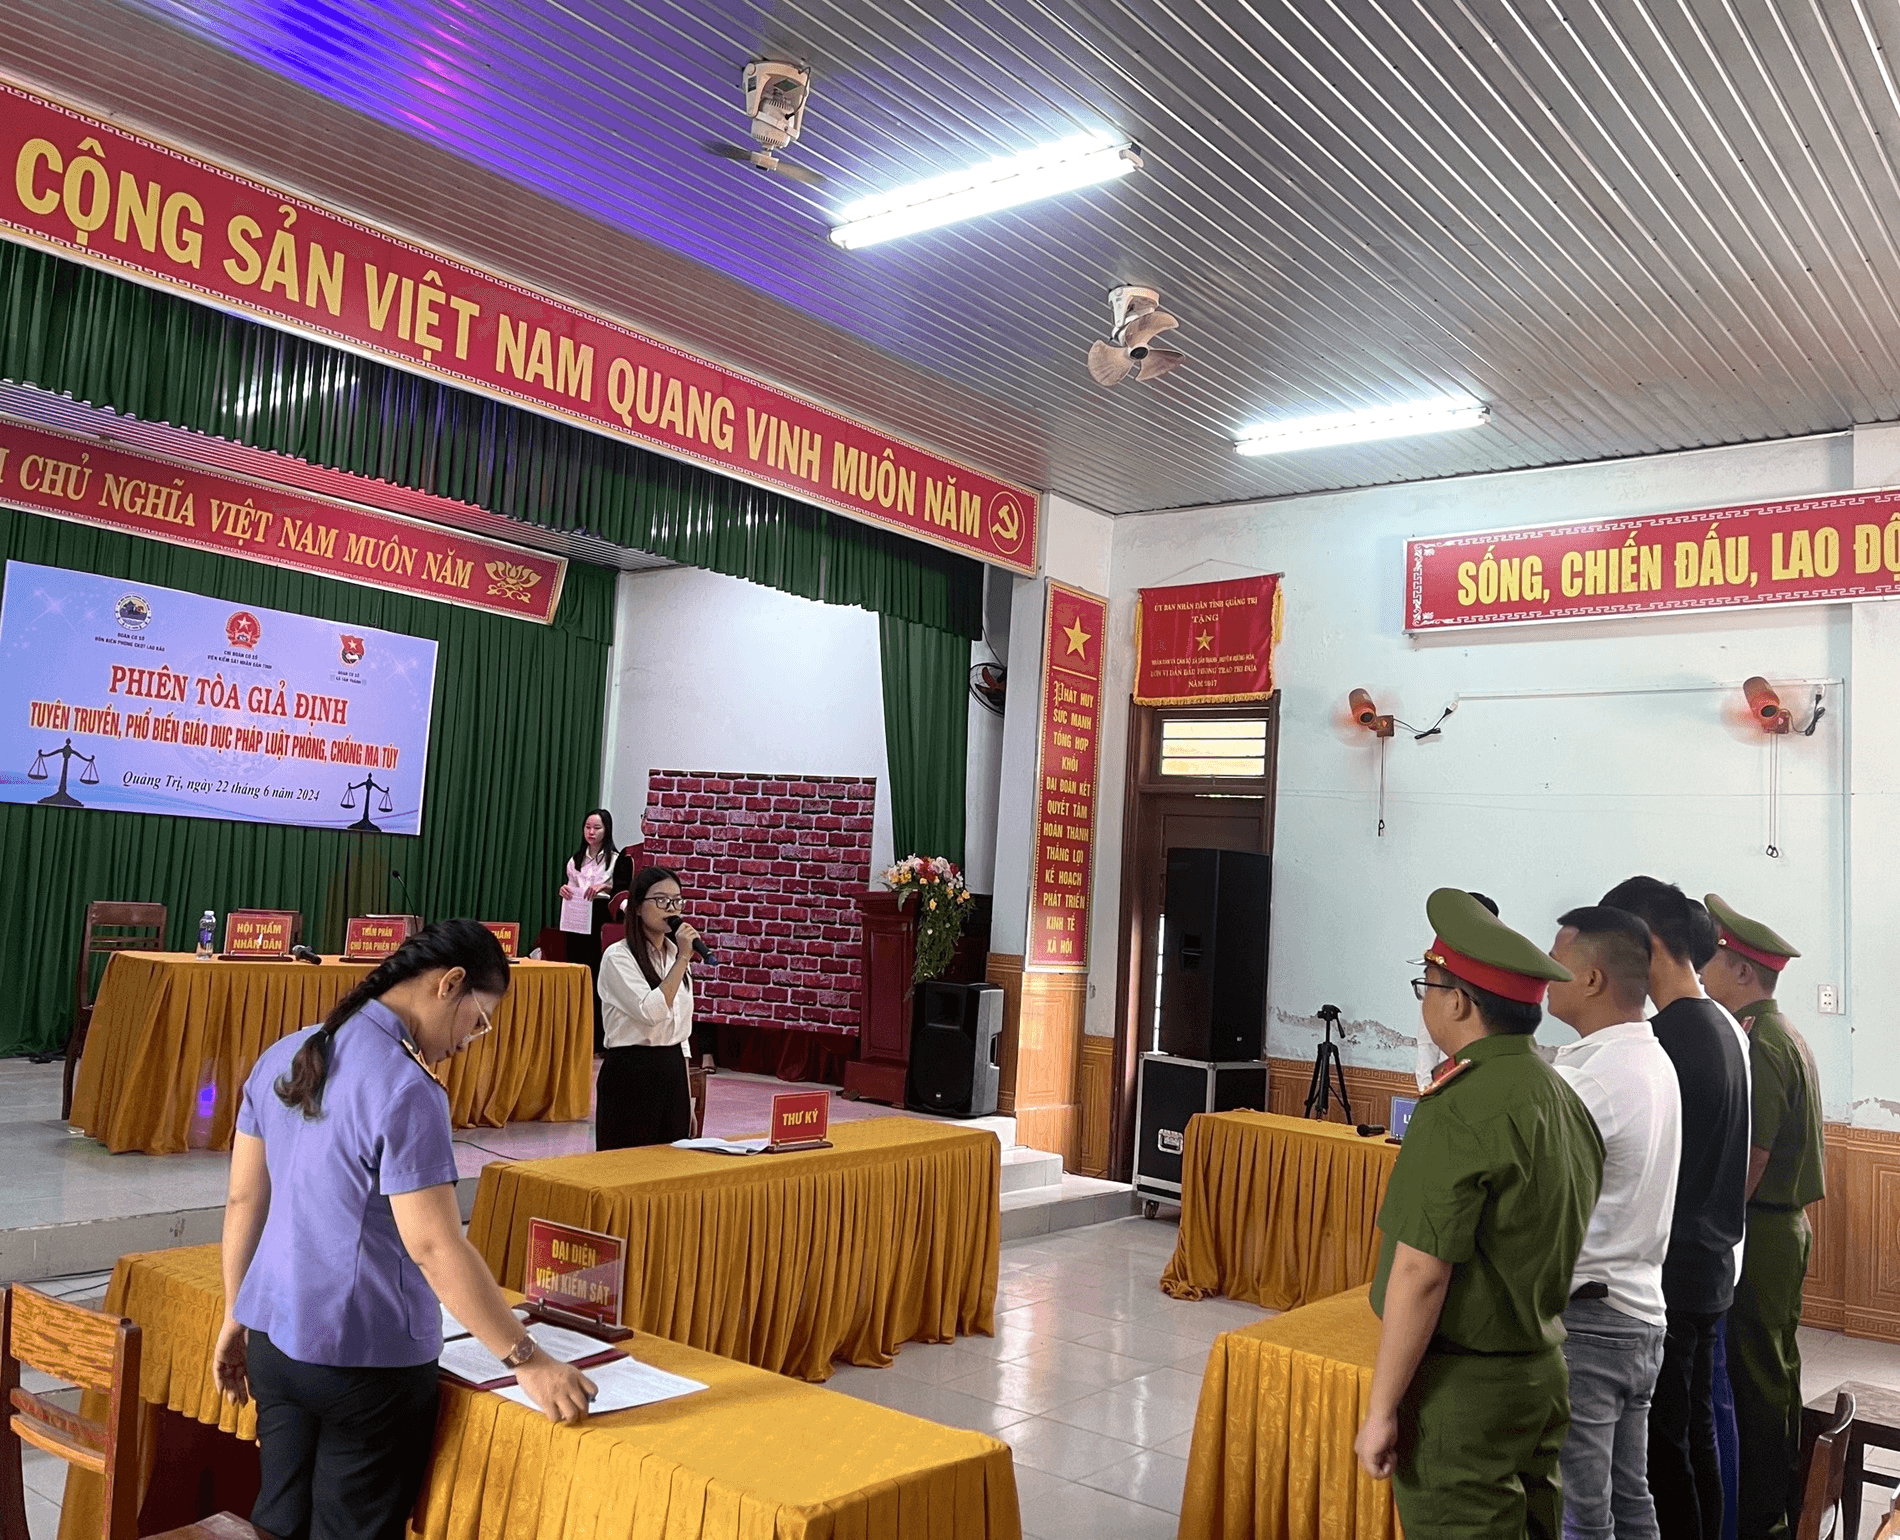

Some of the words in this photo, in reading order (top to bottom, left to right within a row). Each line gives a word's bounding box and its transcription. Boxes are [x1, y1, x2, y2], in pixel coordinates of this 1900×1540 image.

[15, 137, 205, 270] CỘNG
[223, 205, 345, 317] SẢN
[365, 270, 480, 362] VIỆT
[498, 315, 594, 402] NAM
[607, 357, 735, 453] QUANG
[747, 406, 823, 483] VINH
[832, 447, 917, 513] MUÔN
[924, 476, 981, 539] NĂM
[20, 453, 93, 500] CHỦ
[100, 478, 196, 527] NGHĨA
[210, 498, 272, 546] VIỆT
[280, 517, 339, 559] NAM
[348, 534, 417, 578] MUÔN
[420, 546, 474, 591] NĂM
[1458, 545, 1550, 607] SỐNG,
[1560, 531, 1662, 598] CHIẾN
[1674, 523, 1758, 589] ĐẤU,
[1772, 527, 1840, 581] LAO
[1177, 602, 1194, 611] NHÂN
[1195, 601, 1208, 609] DÂN
[1225, 597, 1245, 608] QUẢNG
[1247, 597, 1257, 605] TRỊ
[1192, 614, 1219, 624] TẶNG
[109, 664, 189, 702] PHIÊN
[195, 673, 240, 710] TÒA
[248, 680, 287, 717] GIẢ
[294, 693, 349, 727] ĐỊNH
[1053, 681, 1077, 707] PHÁT
[1080, 693, 1094, 708] HUY
[1053, 706, 1068, 724] SỨC
[1071, 713, 1092, 731] MẠNH
[30, 699, 71, 731] TUYÊN
[74, 703, 122, 739] TRUYỀN,
[125, 707, 152, 740] PHỔ
[152, 711, 180, 743] BIẾN
[182, 718, 208, 747] GIÁO
[210, 725, 233, 754] DỤC
[235, 725, 263, 753] PHÁP
[265, 729, 291, 761] LUẬT
[292, 732, 327, 763] PHÒNG,
[330, 735, 363, 765] CHỐNG
[364, 744, 379, 767] MA
[382, 744, 399, 769] TÚY
[1054, 726, 1072, 748] TỔNG
[1075, 736, 1089, 754] HỢP
[1062, 753, 1079, 772] KHỐI
[123, 771, 161, 789] Quảng
[165, 775, 183, 792] Trị,
[187, 778, 213, 794] ngày
[215, 780, 229, 793] 22
[231, 781, 261, 799] tháng
[263, 785, 270, 797] 6
[272, 787, 294, 799] năm
[296, 789, 320, 801] 2024
[1046, 776, 1057, 794] ĐẠI
[1060, 777, 1077, 795] ĐOÀN
[1079, 778, 1091, 797] KẾT
[1047, 797, 1069, 816] QUYẾT
[1073, 802, 1088, 819] TÂM
[1043, 822, 1063, 838] HOÀN
[1067, 824, 1089, 842] THÀNH
[1046, 842, 1070, 862] THẮNG
[1073, 849, 1084, 867] LỢI
[1045, 864, 1055, 884] KẾ
[1059, 870, 1083, 889] HOẠCH
[1043, 891, 1061, 907] PHÁT
[1065, 889, 1086, 909] TRIỂN
[237, 921, 253, 936] HỘI
[256, 921, 282, 934] THẨM
[1046, 916, 1064, 931] KINH
[1067, 912, 1076, 932] TẾ
[233, 938, 260, 949] NHÂN
[262, 938, 282, 950] DÂN
[1047, 936, 1057, 954] XÃ
[1060, 938, 1073, 957] HỘI
[782, 1111, 804, 1126] THƯ
[805, 1108, 819, 1124] KÝ
[552, 1239, 569, 1264] ĐẠI
[572, 1243, 597, 1270] DIỆN
[536, 1267, 559, 1294] VIỆN
[561, 1270, 587, 1299] KIỂM
[590, 1281, 610, 1306] SÁT
